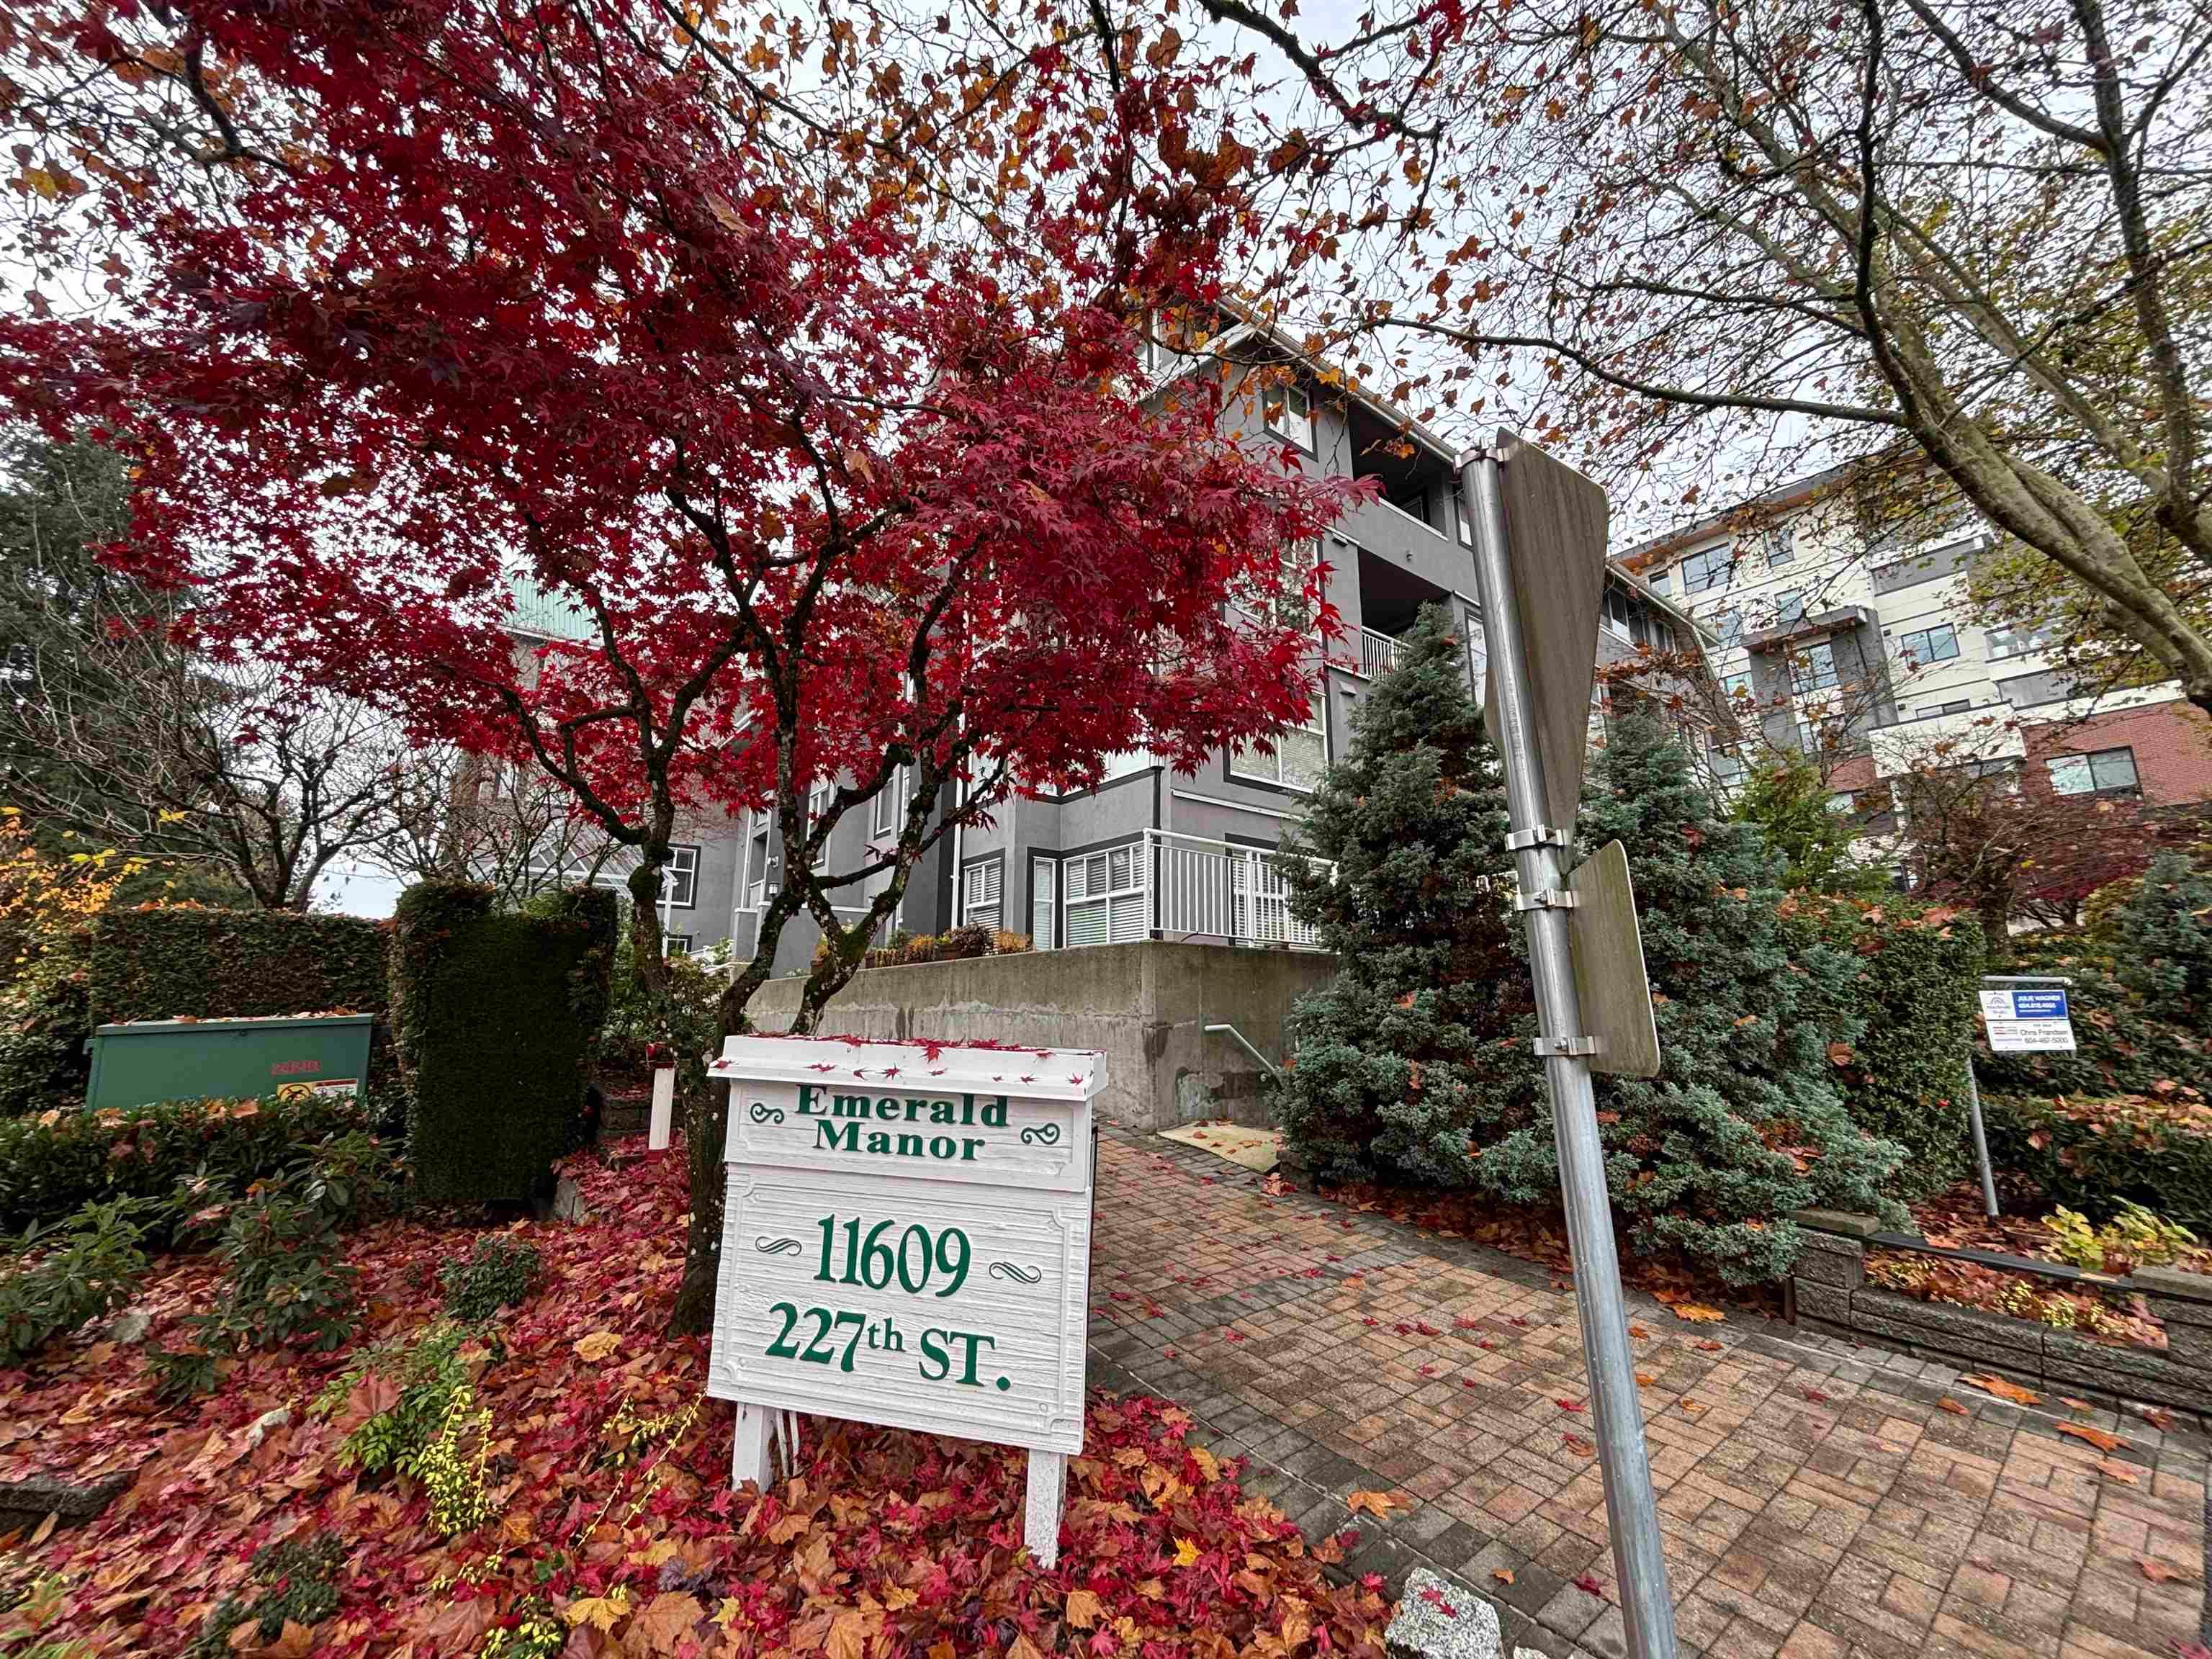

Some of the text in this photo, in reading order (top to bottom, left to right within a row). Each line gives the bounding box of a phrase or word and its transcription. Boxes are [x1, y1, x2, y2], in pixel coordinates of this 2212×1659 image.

[794, 1084, 1009, 1128] Emerald
[812, 1118, 986, 1161] Manor
[813, 1213, 972, 1298] 11609
[764, 1302, 1012, 1391] 227th ST.
